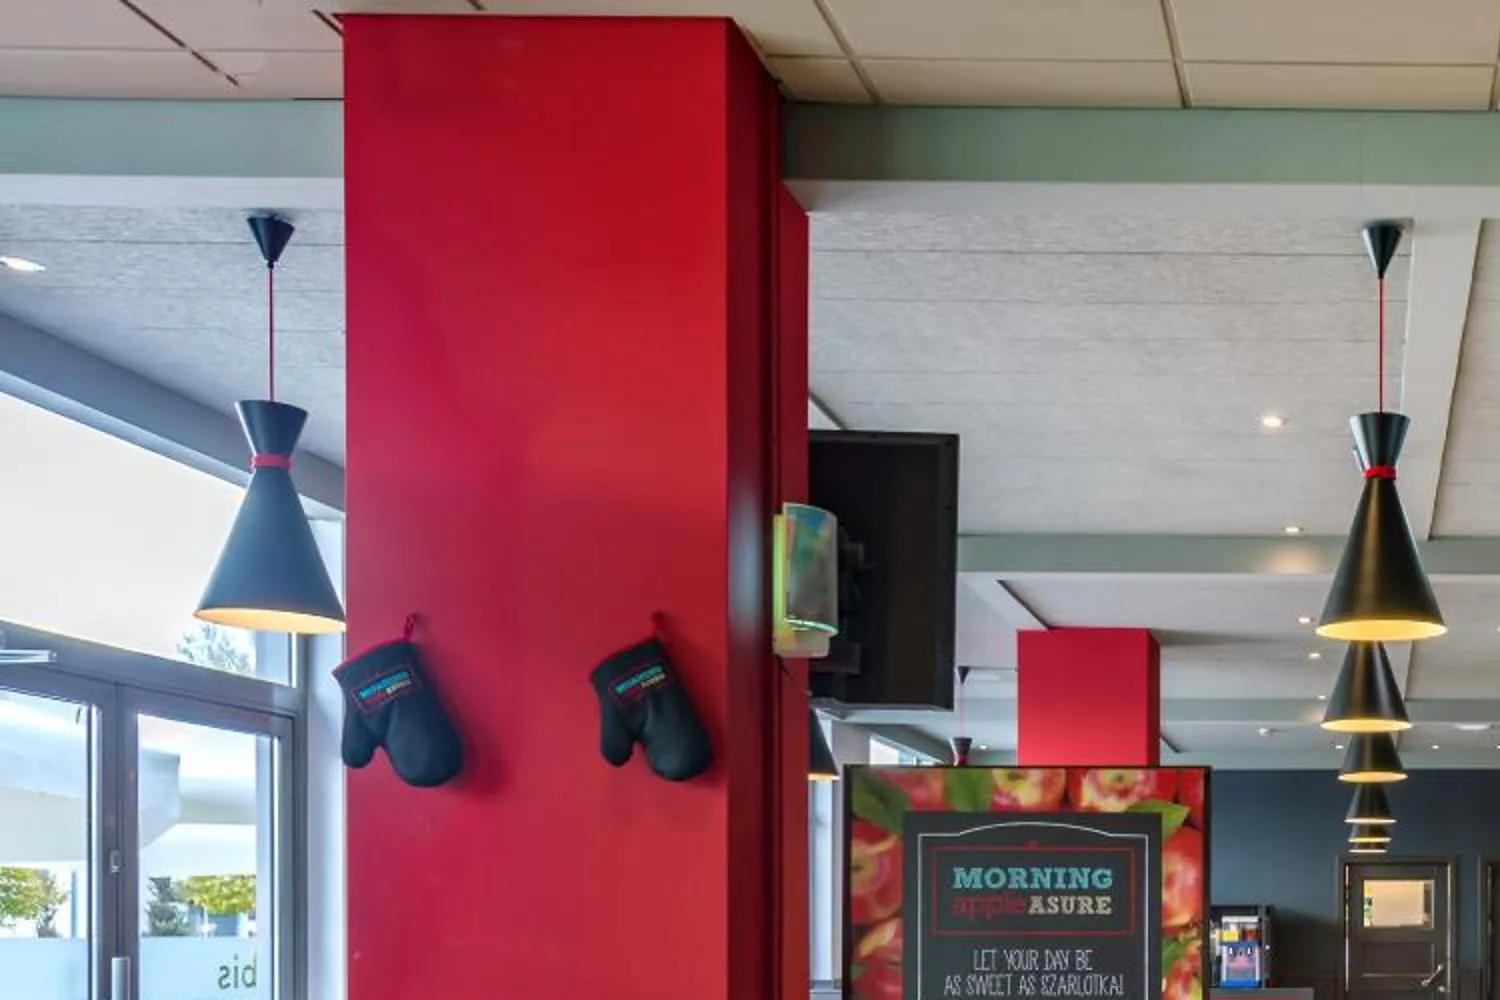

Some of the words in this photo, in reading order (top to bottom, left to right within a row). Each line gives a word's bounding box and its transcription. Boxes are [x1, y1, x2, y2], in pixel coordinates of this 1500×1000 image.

[952, 867, 1113, 889] MORNING
[1028, 895, 1112, 915] ASURE
[973, 949, 997, 971] LET
[1003, 949, 1039, 971] YOUR
[1043, 949, 1069, 971] DAY
[1075, 949, 1093, 971] BE
[943, 974, 961, 996] AS
[966, 974, 1013, 996] SWEET
[1018, 974, 1036, 996] AS
[1041, 974, 1125, 996] SZARLOTKA!
